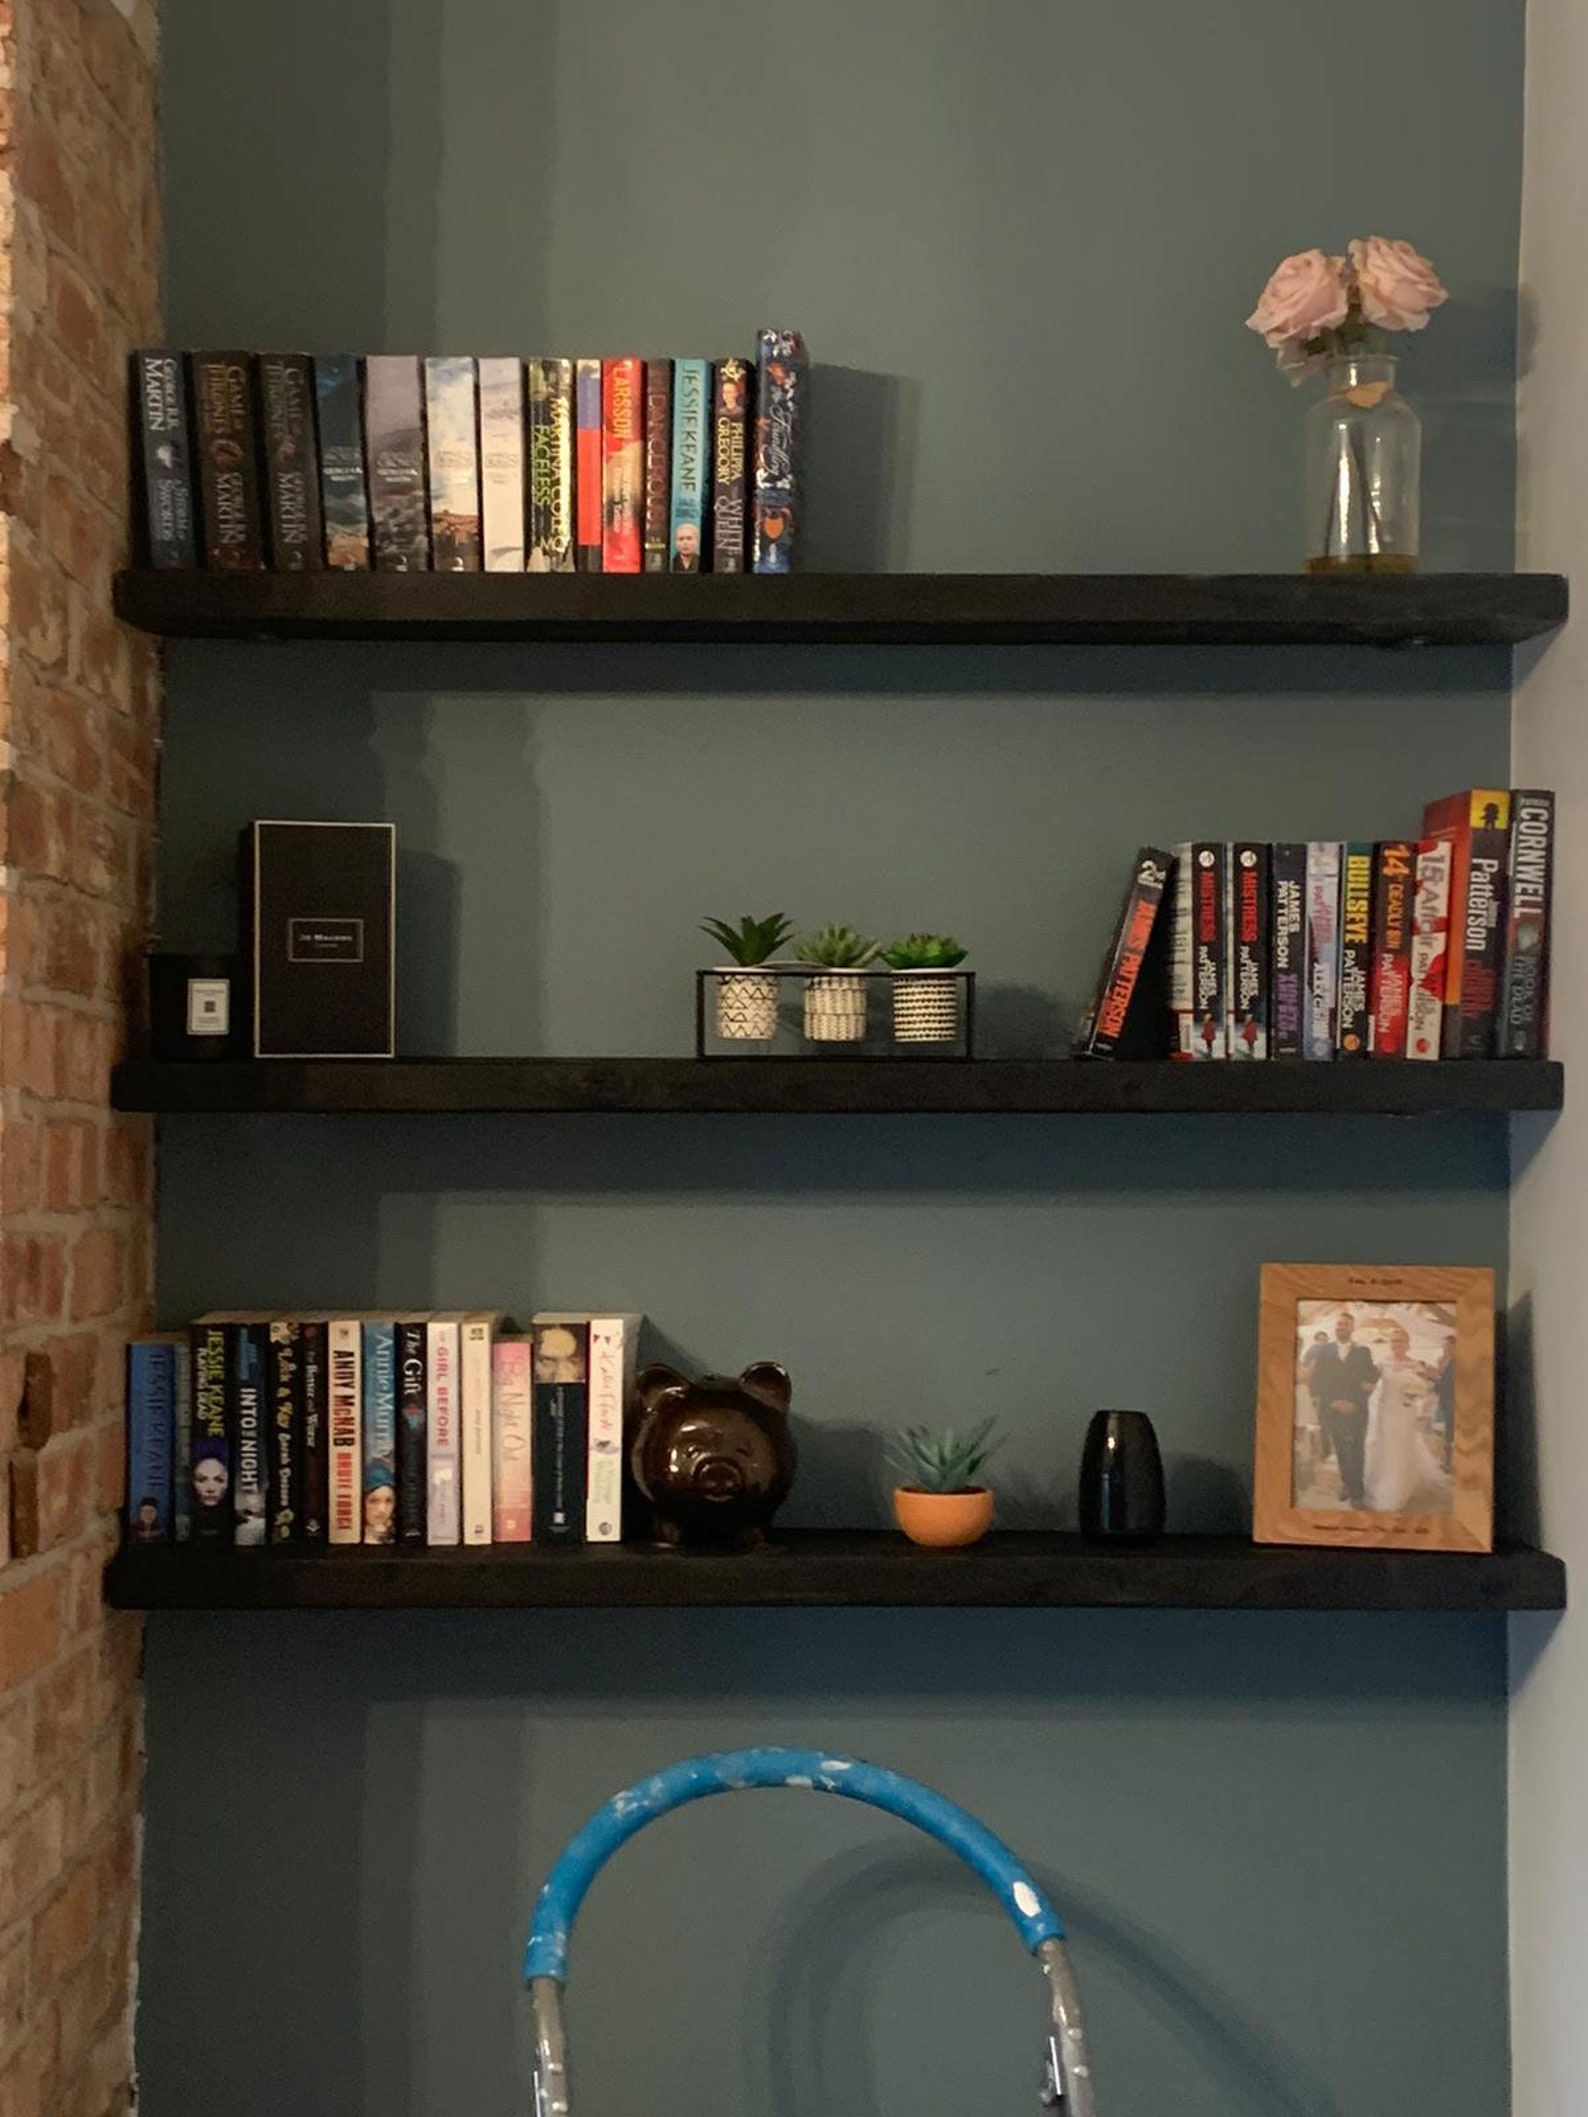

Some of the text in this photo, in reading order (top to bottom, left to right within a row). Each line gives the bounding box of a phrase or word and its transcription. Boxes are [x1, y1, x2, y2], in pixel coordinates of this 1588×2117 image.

[144, 357, 165, 432] MARTIN
[202, 361, 230, 434] THRONES
[228, 365, 246, 414] GAME
[612, 366, 633, 439] LARSSON
[679, 368, 699, 424] JESSIE
[534, 425, 551, 506] FACELESS
[679, 430, 698, 492] KEANE
[717, 416, 730, 486] GREGORY
[730, 421, 744, 481] PHILIPPA
[214, 471, 235, 544] MARTIN
[277, 472, 298, 545] MARTIN
[714, 495, 730, 551] QUEEN
[727, 498, 743, 555] WHITE
[1513, 807, 1549, 919] CORNWELL
[1127, 898, 1157, 953] JAMES
[1199, 871, 1217, 943] MISTRESS
[1240, 871, 1258, 942] MISTRESS
[1277, 880, 1289, 968] PATTERSON
[1289, 880, 1301, 933] JAMES
[1345, 855, 1371, 944] BULLSEYE
[1387, 882, 1404, 928] DEADLY
[1420, 889, 1441, 950] Affair
[1465, 857, 1499, 951] Patterson
[1101, 952, 1143, 1039] PATTERSON
[1198, 945, 1209, 1010] PATTERSON
[1207, 961, 1217, 996] JAMES
[1239, 945, 1250, 1010] PATTERSON
[1249, 961, 1260, 997] JAMES
[1342, 949, 1357, 1028] PATTERSON
[1354, 968, 1366, 1011] JAMES
[1378, 953, 1394, 1033] PATTERSON
[1389, 973, 1402, 1017] JAMES
[333, 1350, 354, 1389] ANDY
[376, 1334, 394, 1390] Annie
[405, 1329, 422, 1355] The
[436, 1346, 450, 1381] GIRL
[207, 1329, 225, 1437] JESSIE KEANE
[403, 1358, 425, 1395] Gift
[147, 1353, 166, 1488] JESSIE KEANE
[239, 1387, 257, 1428] INTO
[333, 1395, 354, 1447] McNAB
[436, 1387, 450, 1447] BEFORE
[496, 1393, 526, 1427] Night
[240, 1439, 258, 1492] NIGHT
[502, 1434, 526, 1461] Out
